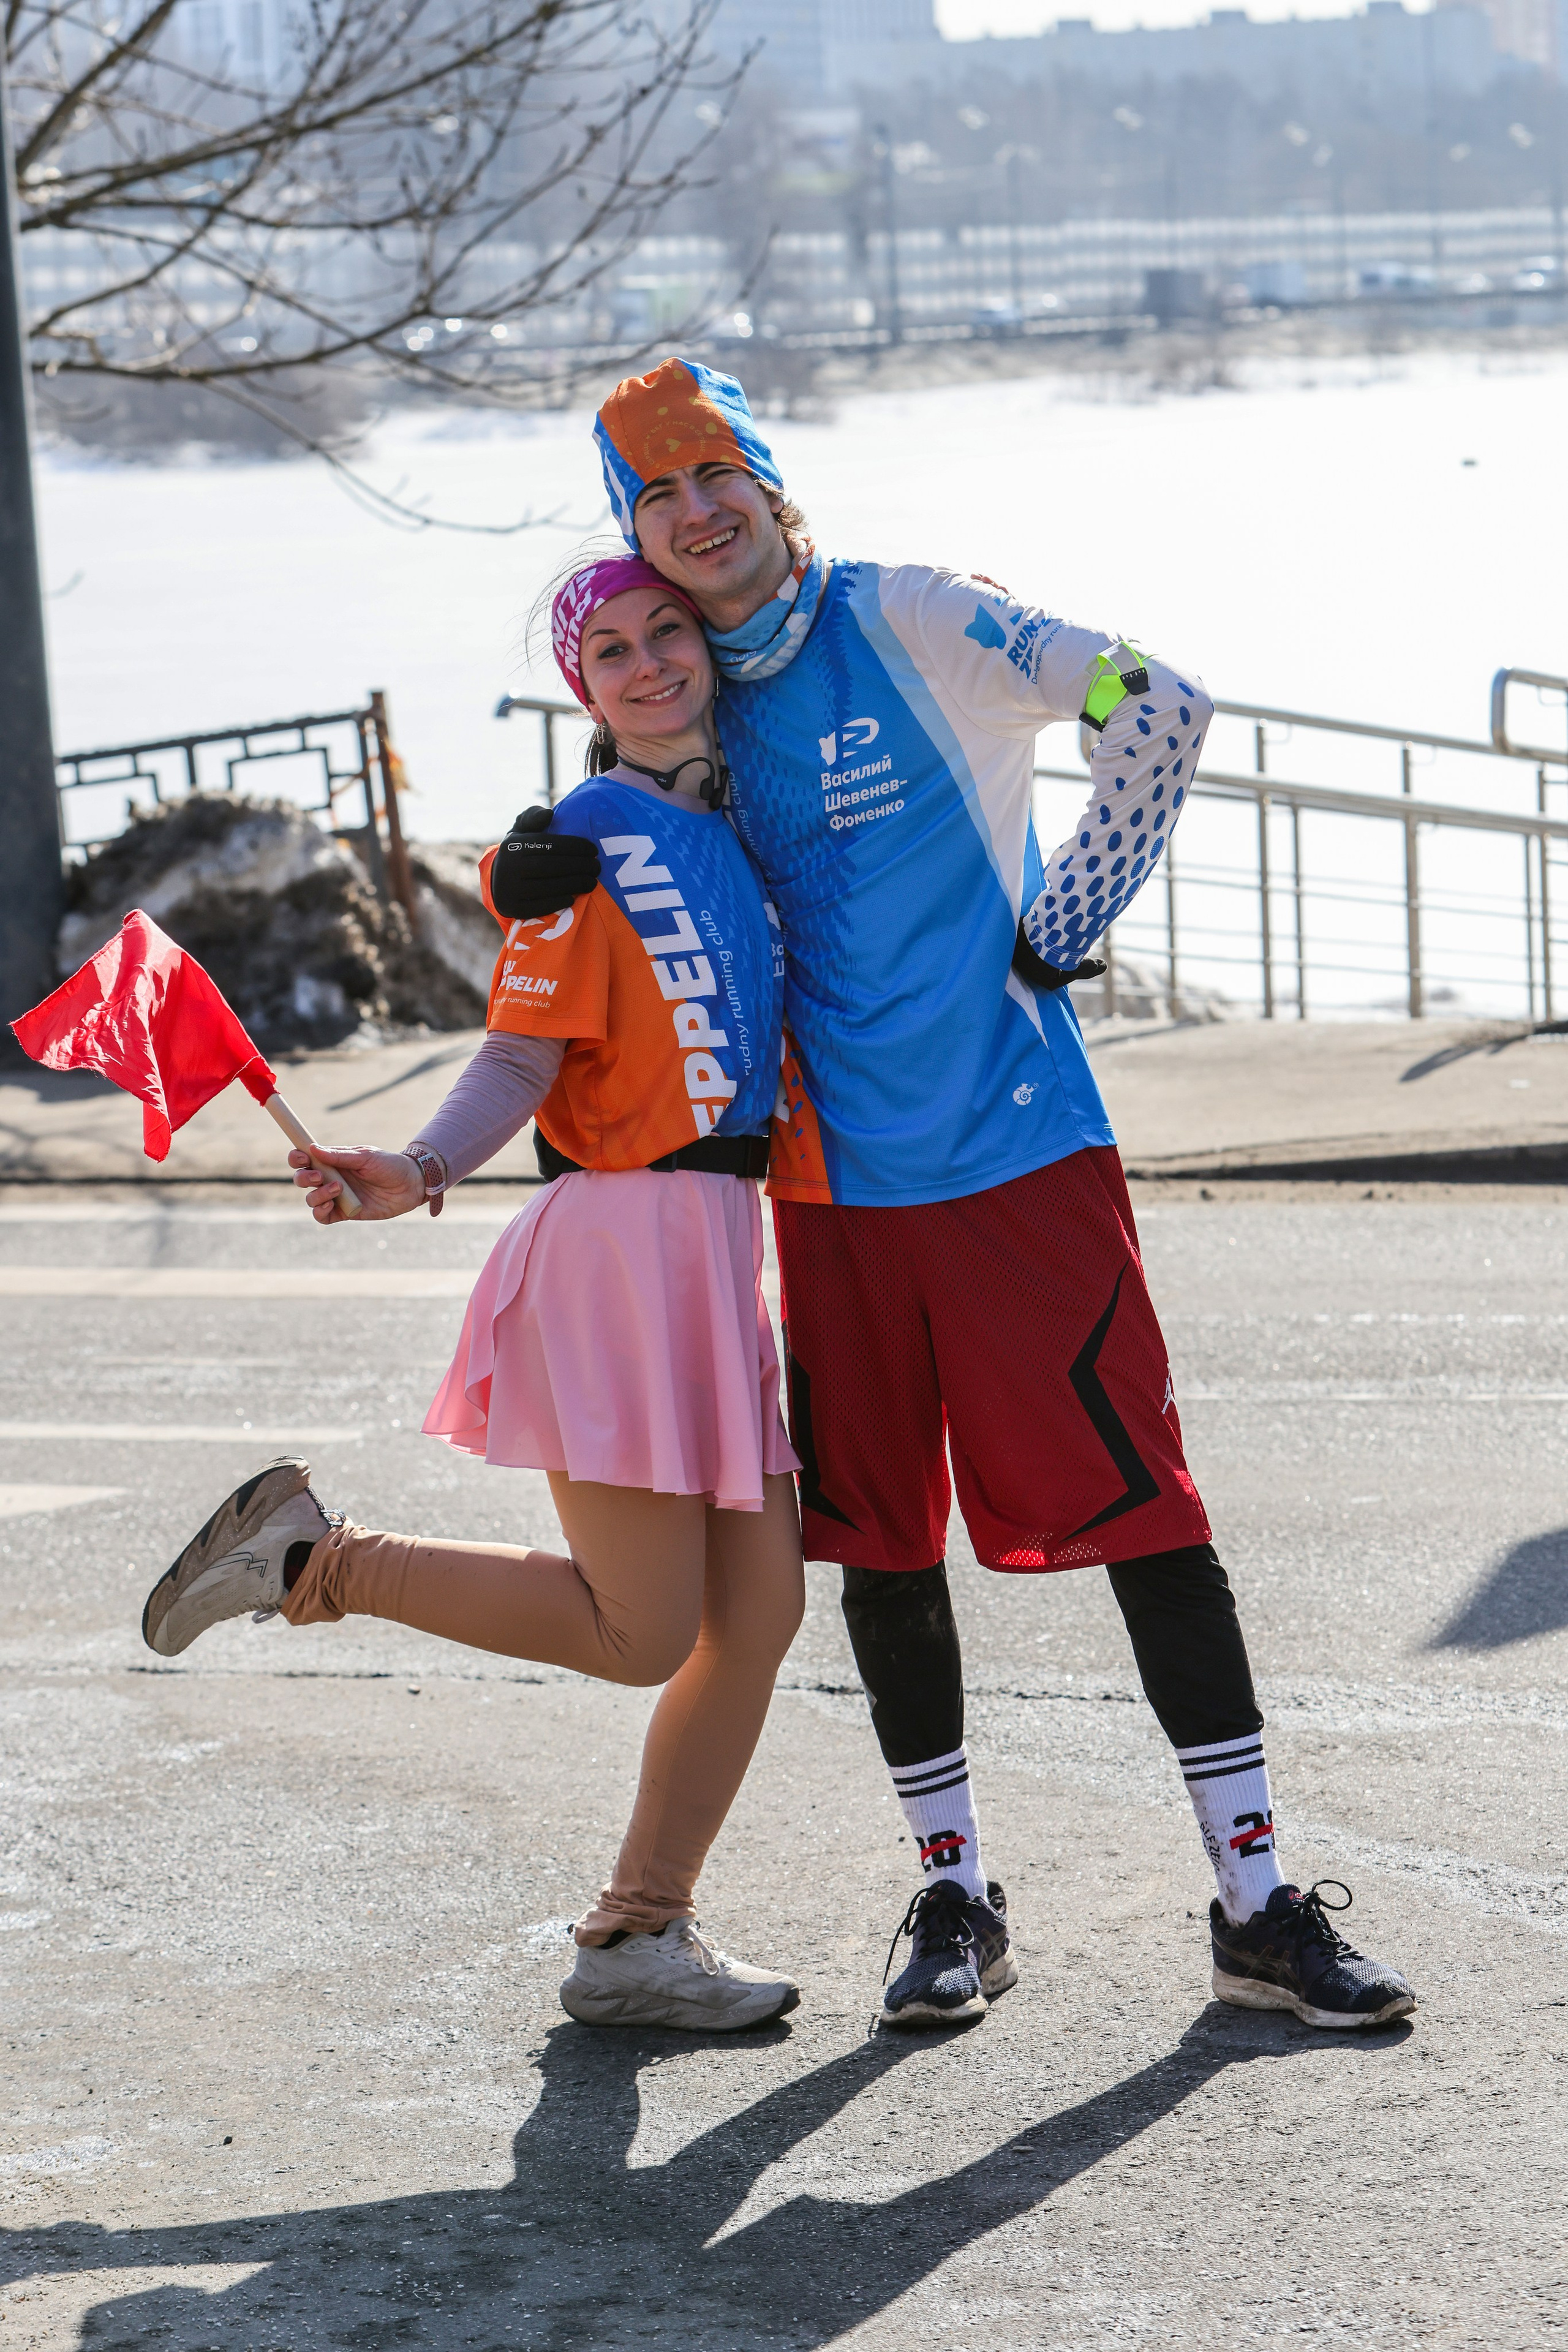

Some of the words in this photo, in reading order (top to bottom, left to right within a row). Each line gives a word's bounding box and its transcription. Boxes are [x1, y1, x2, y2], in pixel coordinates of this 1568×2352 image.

[729, 772, 741, 805] club
[821, 754, 892, 791] Василий
[825, 779, 908, 813] Шевенев-
[829, 799, 905, 831] Фоменко
[699, 910, 723, 946] club
[718, 950, 744, 1019] running
[507, 997, 533, 1007] running
